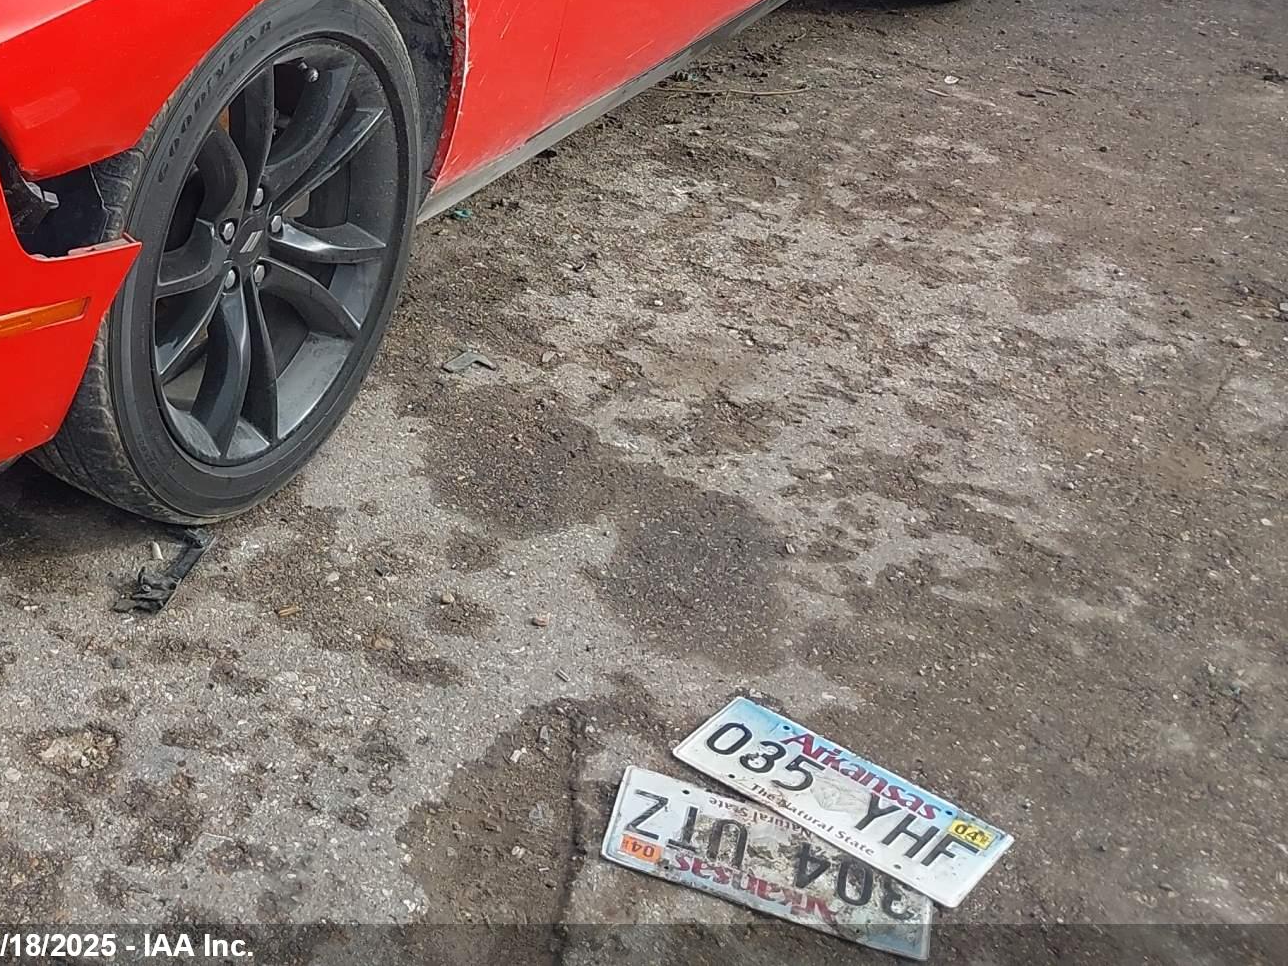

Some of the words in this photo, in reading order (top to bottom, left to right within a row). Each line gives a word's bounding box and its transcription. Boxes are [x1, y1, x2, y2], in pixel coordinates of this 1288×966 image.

[706, 722, 826, 791] 035
[854, 792, 981, 867] YHF
[780, 733, 940, 821] Arkansas
[625, 789, 748, 870] UTZ
[777, 795, 834, 834] Natural
[837, 826, 876, 857] State
[674, 854, 839, 924] Arkansas
